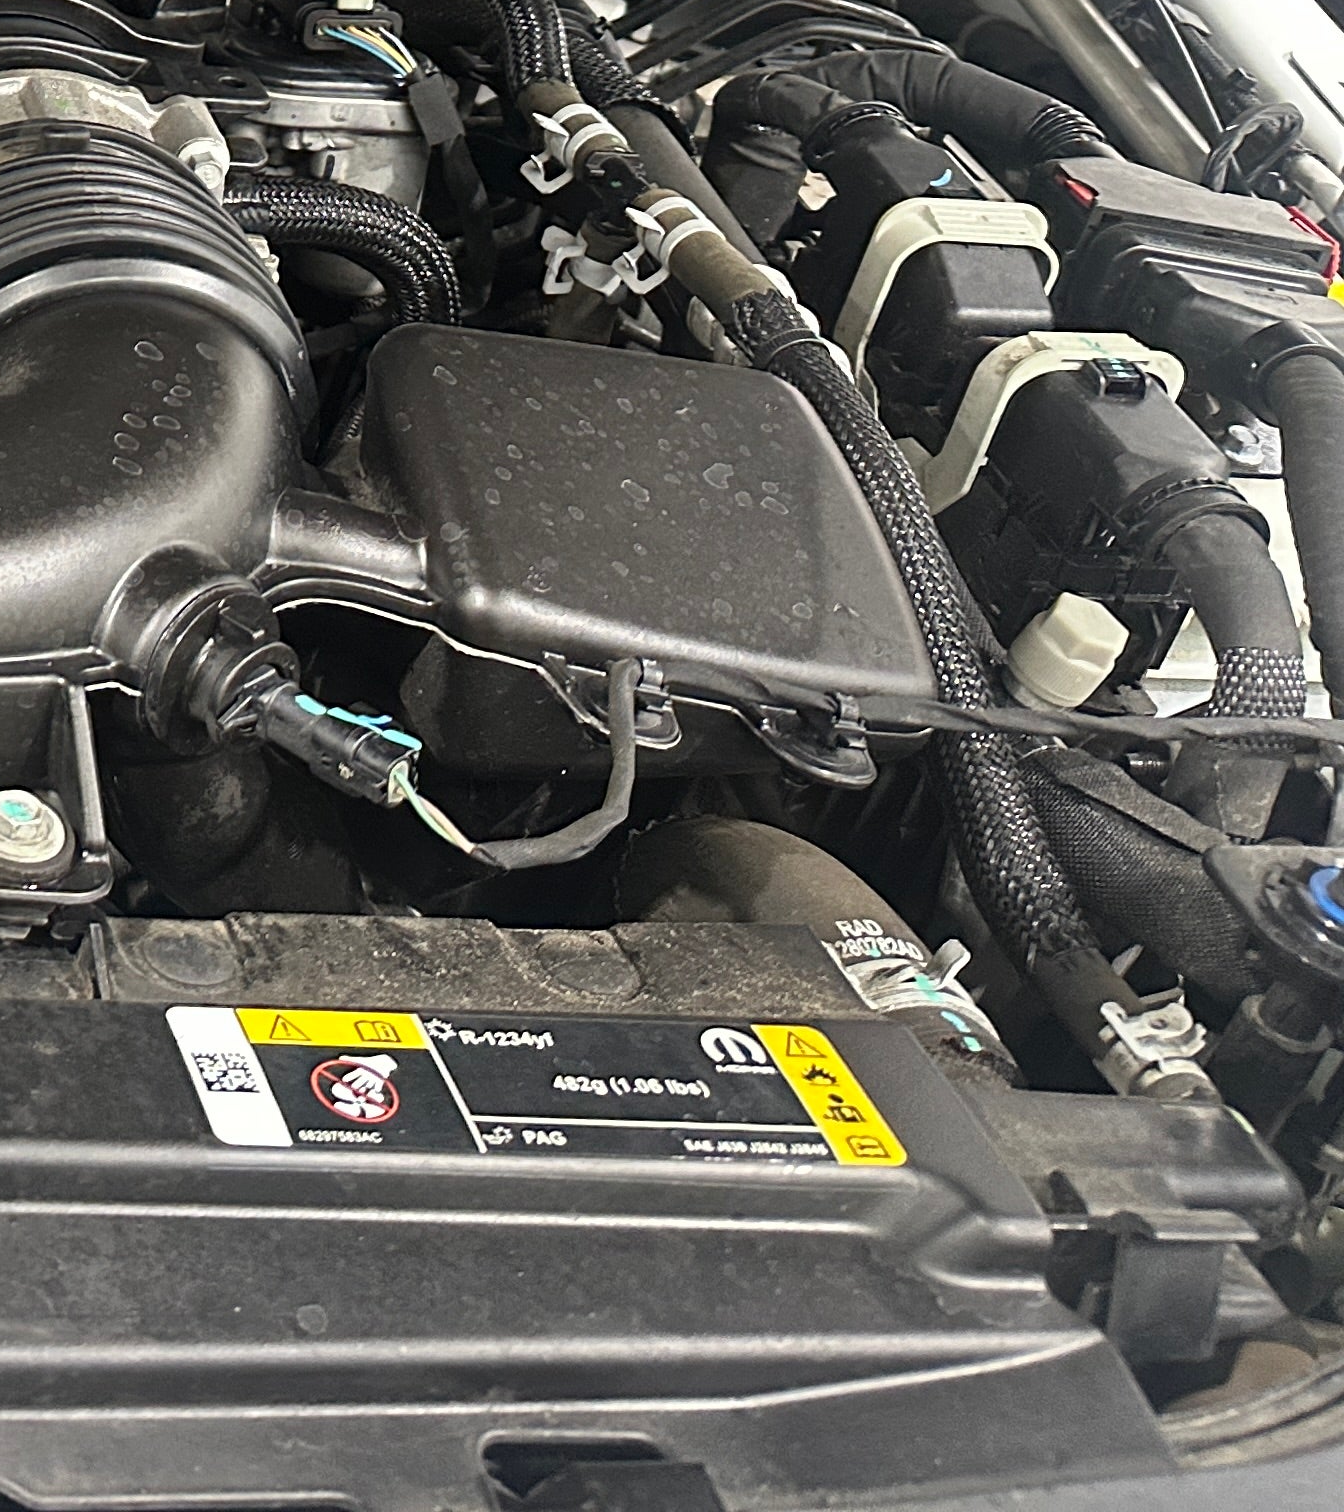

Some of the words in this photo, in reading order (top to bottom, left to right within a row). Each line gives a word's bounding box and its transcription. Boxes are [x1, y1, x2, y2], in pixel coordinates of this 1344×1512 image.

[835, 919, 884, 937] RAD
[553, 1075, 609, 1096] 482g
[609, 1077, 664, 1096] (1.06
[664, 1079, 711, 1098] lbs)
[521, 1129, 567, 1146] PAG
